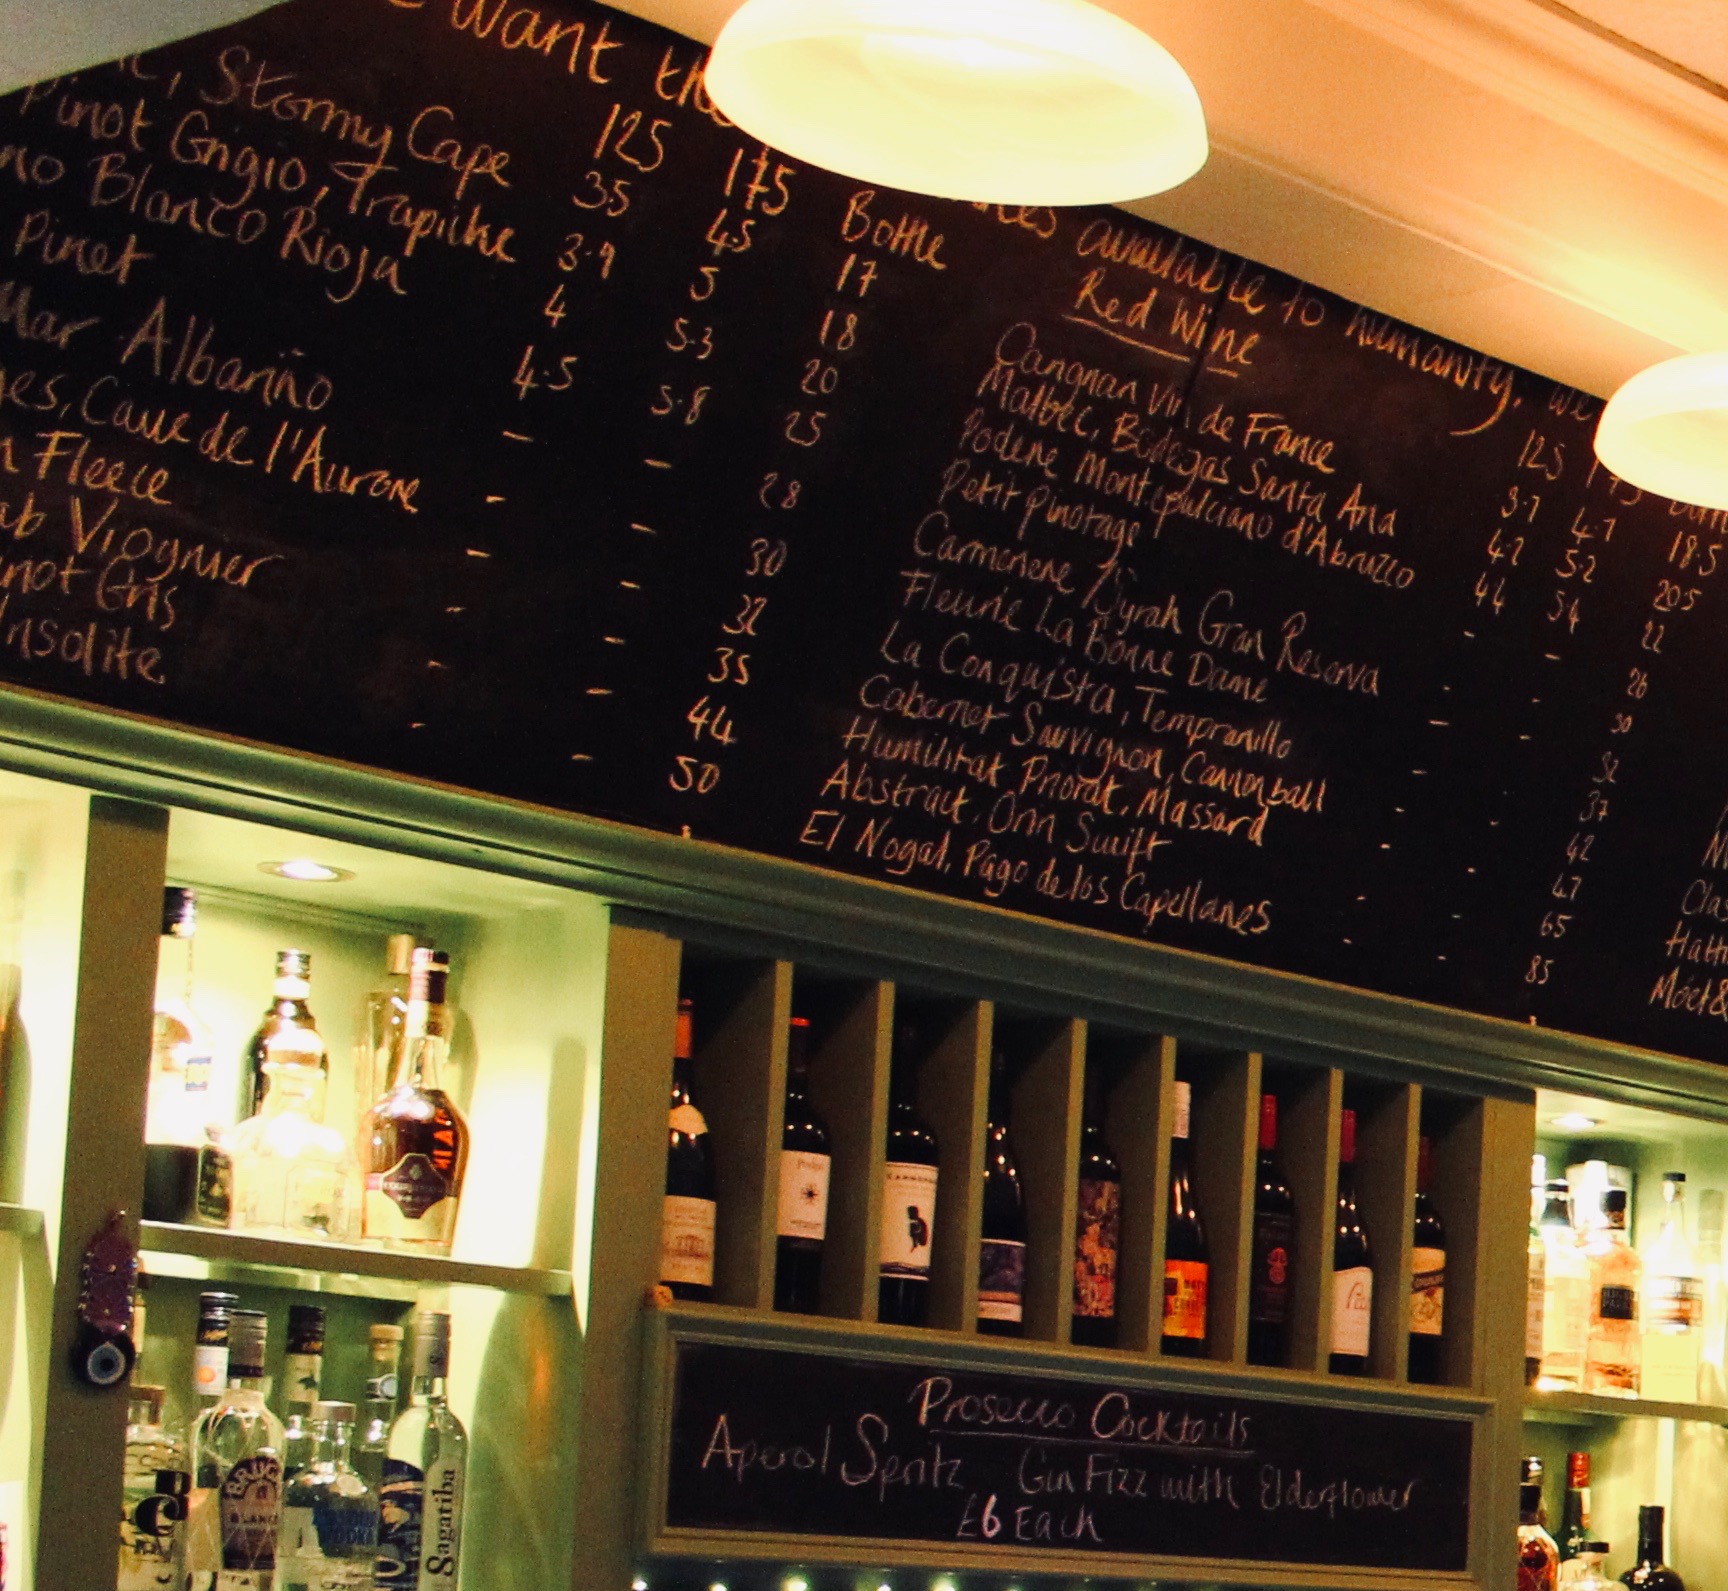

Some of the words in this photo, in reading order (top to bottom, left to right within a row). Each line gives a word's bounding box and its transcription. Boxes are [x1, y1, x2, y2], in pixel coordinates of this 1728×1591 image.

[200, 45, 392, 168] Stormy
[408, 105, 511, 200] Cape
[593, 102, 673, 172] 125
[724, 146, 797, 216] 175
[88, 152, 268, 246] Blanco
[281, 204, 408, 303] Rioja
[690, 266, 720, 300] 5
[836, 253, 878, 297] 17
[1076, 218, 1268, 315] available
[544, 284, 567, 328] 4
[820, 310, 858, 350] 18
[1075, 267, 1158, 330] Red
[1170, 300, 1261, 366] Wine
[802, 359, 838, 394] 20
[200, 409, 255, 466] de
[785, 411, 828, 447] 25
[1200, 402, 1234, 443] de
[1244, 412, 1336, 475] France
[1518, 429, 1566, 481] 125
[33, 430, 172, 506] Fleece
[759, 472, 801, 510] 28
[939, 459, 1022, 512] Petit
[1239, 459, 1323, 520] Santa
[746, 538, 787, 577] 30
[882, 620, 921, 668] La
[1036, 596, 1074, 648] La
[1187, 651, 1268, 705] Dame
[1199, 590, 1266, 661] Gran
[707, 647, 751, 686] 35
[687, 695, 738, 747] 44
[669, 755, 720, 795] 50
[800, 809, 839, 852] El
[962, 840, 1029, 897] Pago
[1036, 856, 1070, 897] de
[1540, 911, 1575, 940] 65
[1524, 954, 1555, 985] 85
[907, 1375, 1076, 1427] Prosecco
[1091, 1392, 1251, 1445] Cocktails
[701, 1413, 831, 1483] Aperol
[841, 1411, 965, 1502] Spritz
[1019, 1446, 1075, 1496] Gin
[1085, 1453, 1147, 1499] Fizz
[1160, 1465, 1239, 1511] with
[425, 1469, 457, 1578] Sagatiba
